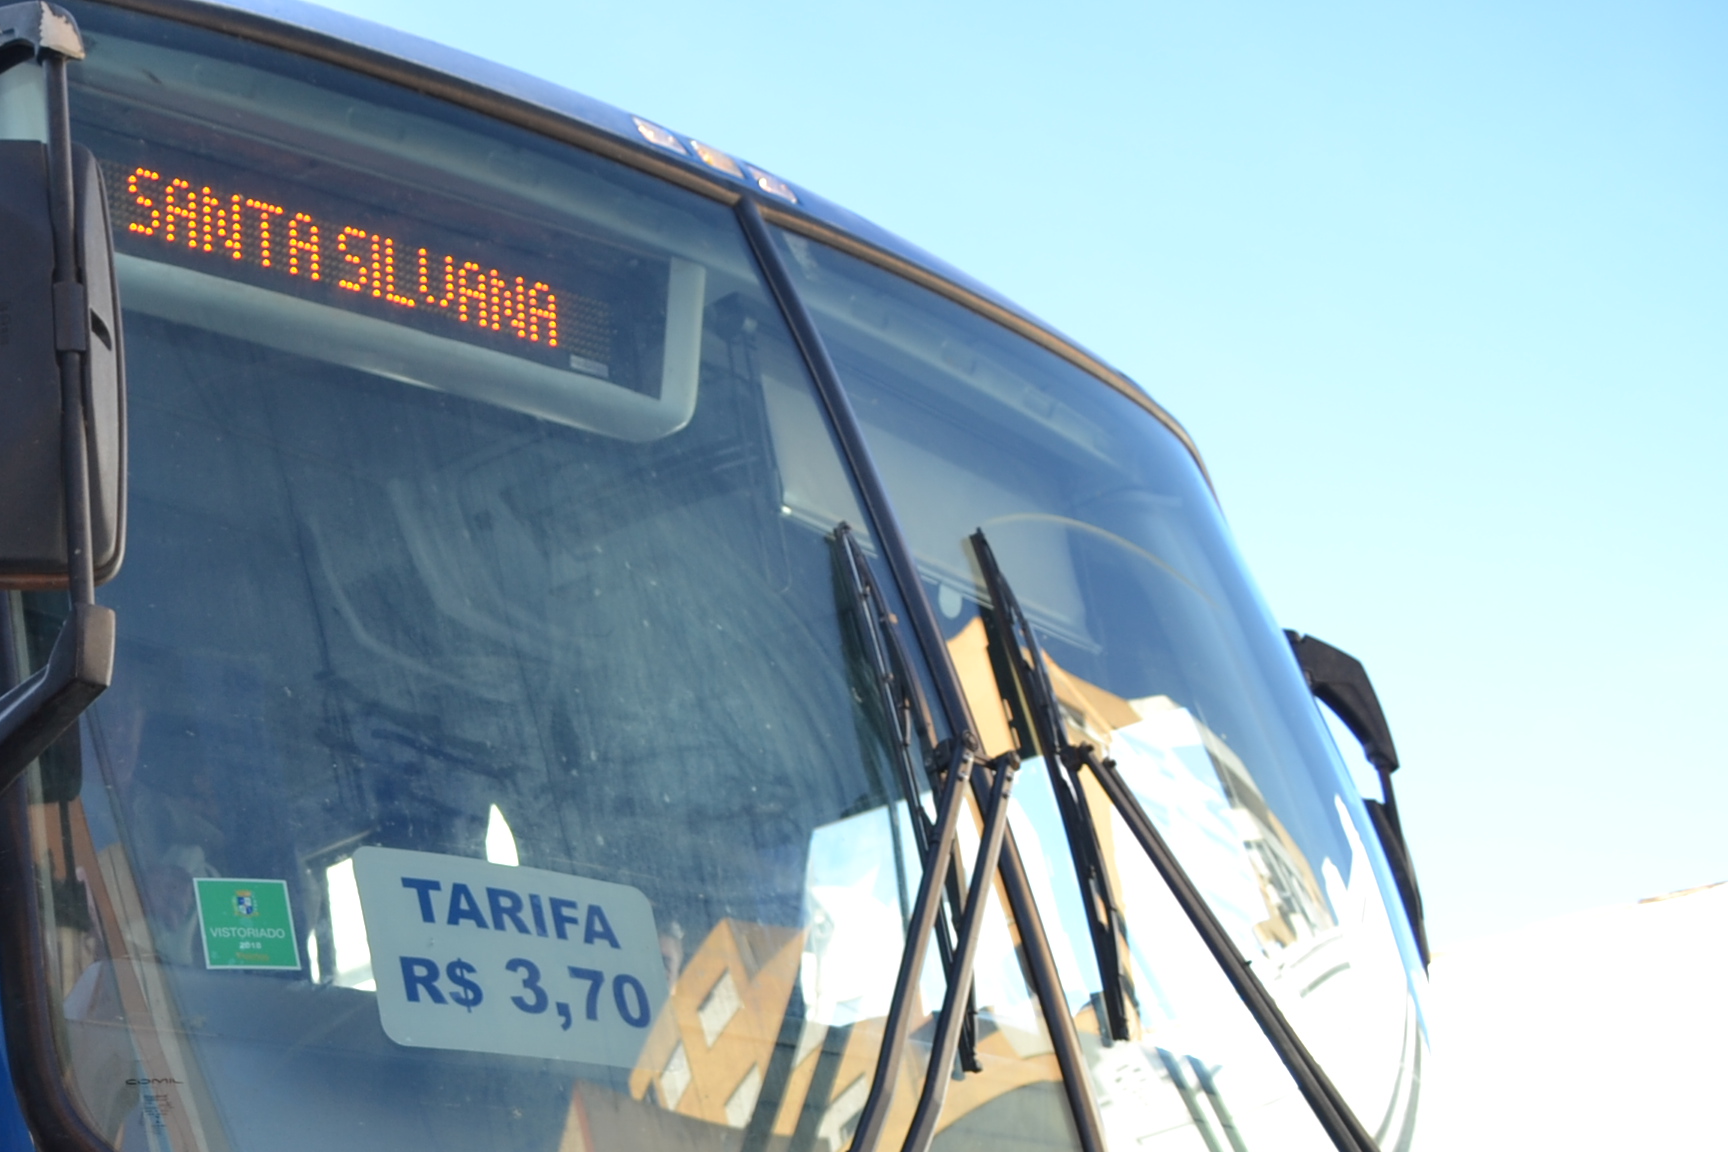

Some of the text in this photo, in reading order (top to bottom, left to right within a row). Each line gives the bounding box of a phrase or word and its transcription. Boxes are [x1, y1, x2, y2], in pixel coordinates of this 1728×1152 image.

[128, 167, 558, 347] SANTA SILVANA
[209, 927, 286, 939] VISTORIADO
[400, 876, 622, 950] TARIFA
[398, 955, 652, 1032] R$ 3,70
